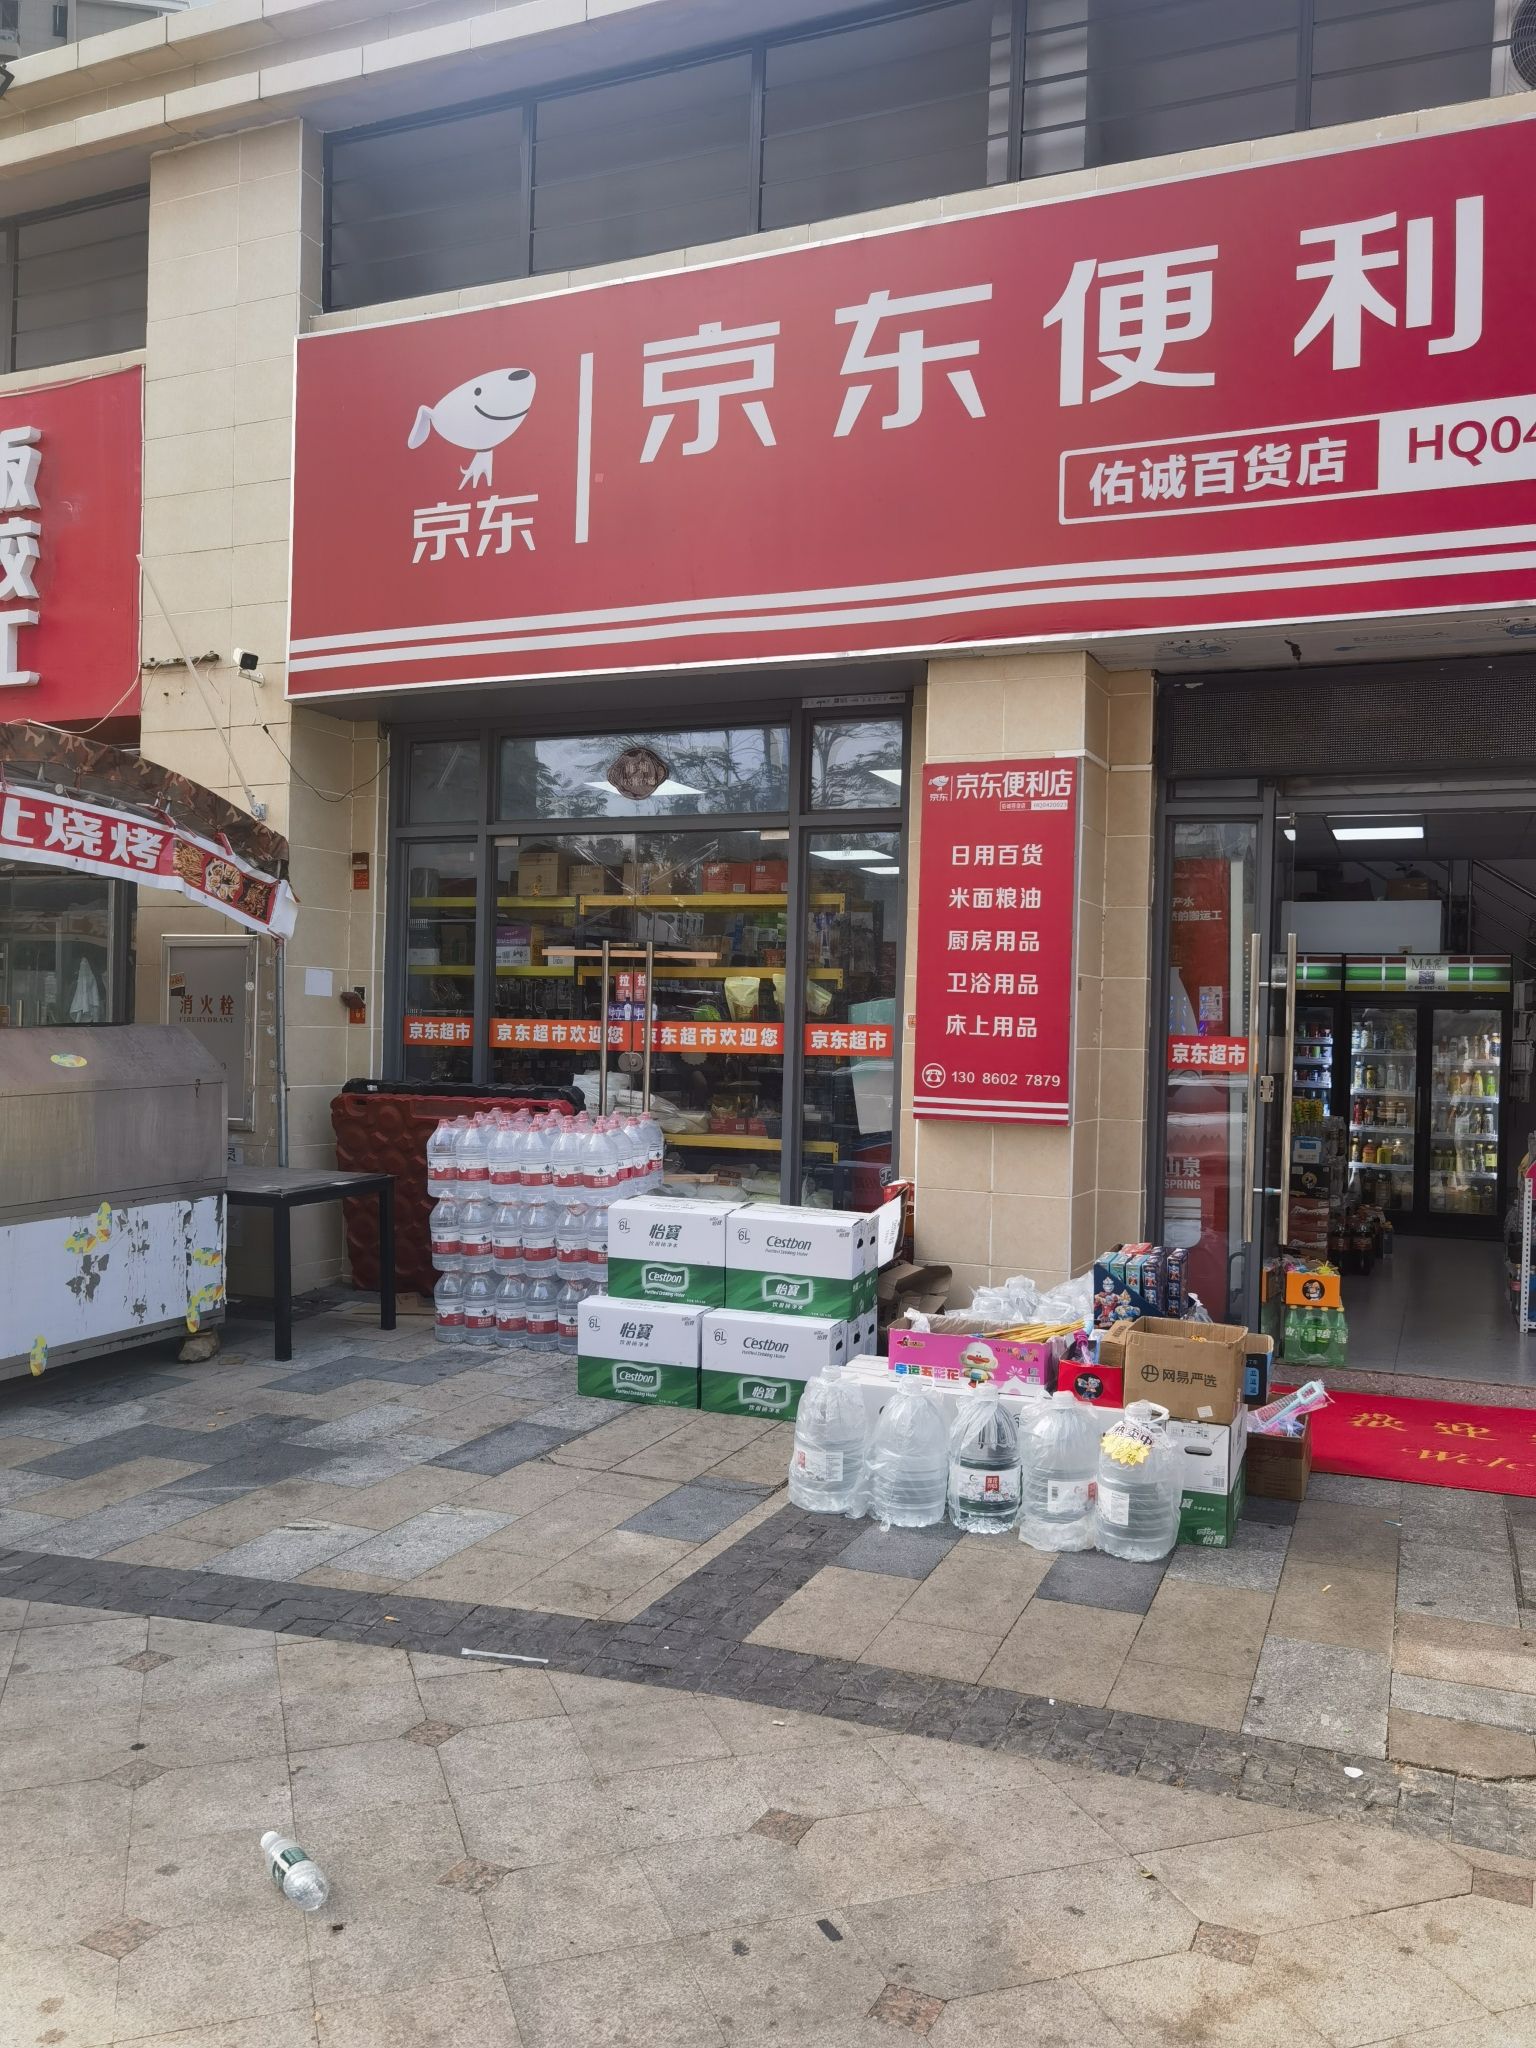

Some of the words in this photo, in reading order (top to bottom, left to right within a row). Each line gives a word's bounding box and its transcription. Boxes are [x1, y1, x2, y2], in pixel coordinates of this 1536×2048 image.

[640, 195, 1484, 463] 京东便利
[1089, 437, 1347, 507] 佑诚百货店
[412, 494, 538, 563] 京东
[956, 769, 1073, 799] 京东便利店
[952, 843, 1043, 866] 日用百货
[949, 887, 1041, 909] 米面粮油
[948, 930, 1040, 951] 厨房用品
[947, 972, 1039, 995] 卫浴用品
[180, 994, 234, 1015] 消火栓
[409, 1021, 471, 1041] 京东超市
[497, 1023, 624, 1045] 京东超市欢迎您
[946, 1014, 1038, 1037] 床上用品
[810, 1029, 887, 1051] 京东超市
[1171, 1043, 1246, 1066] 京东超市
[952, 1071, 975, 1084] 130
[983, 1072, 1018, 1085] 8602
[1025, 1073, 1061, 1087] 7879
[895, 1363, 960, 1381] 幸运五彩花
[1162, 1368, 1217, 1388] 网易严选
